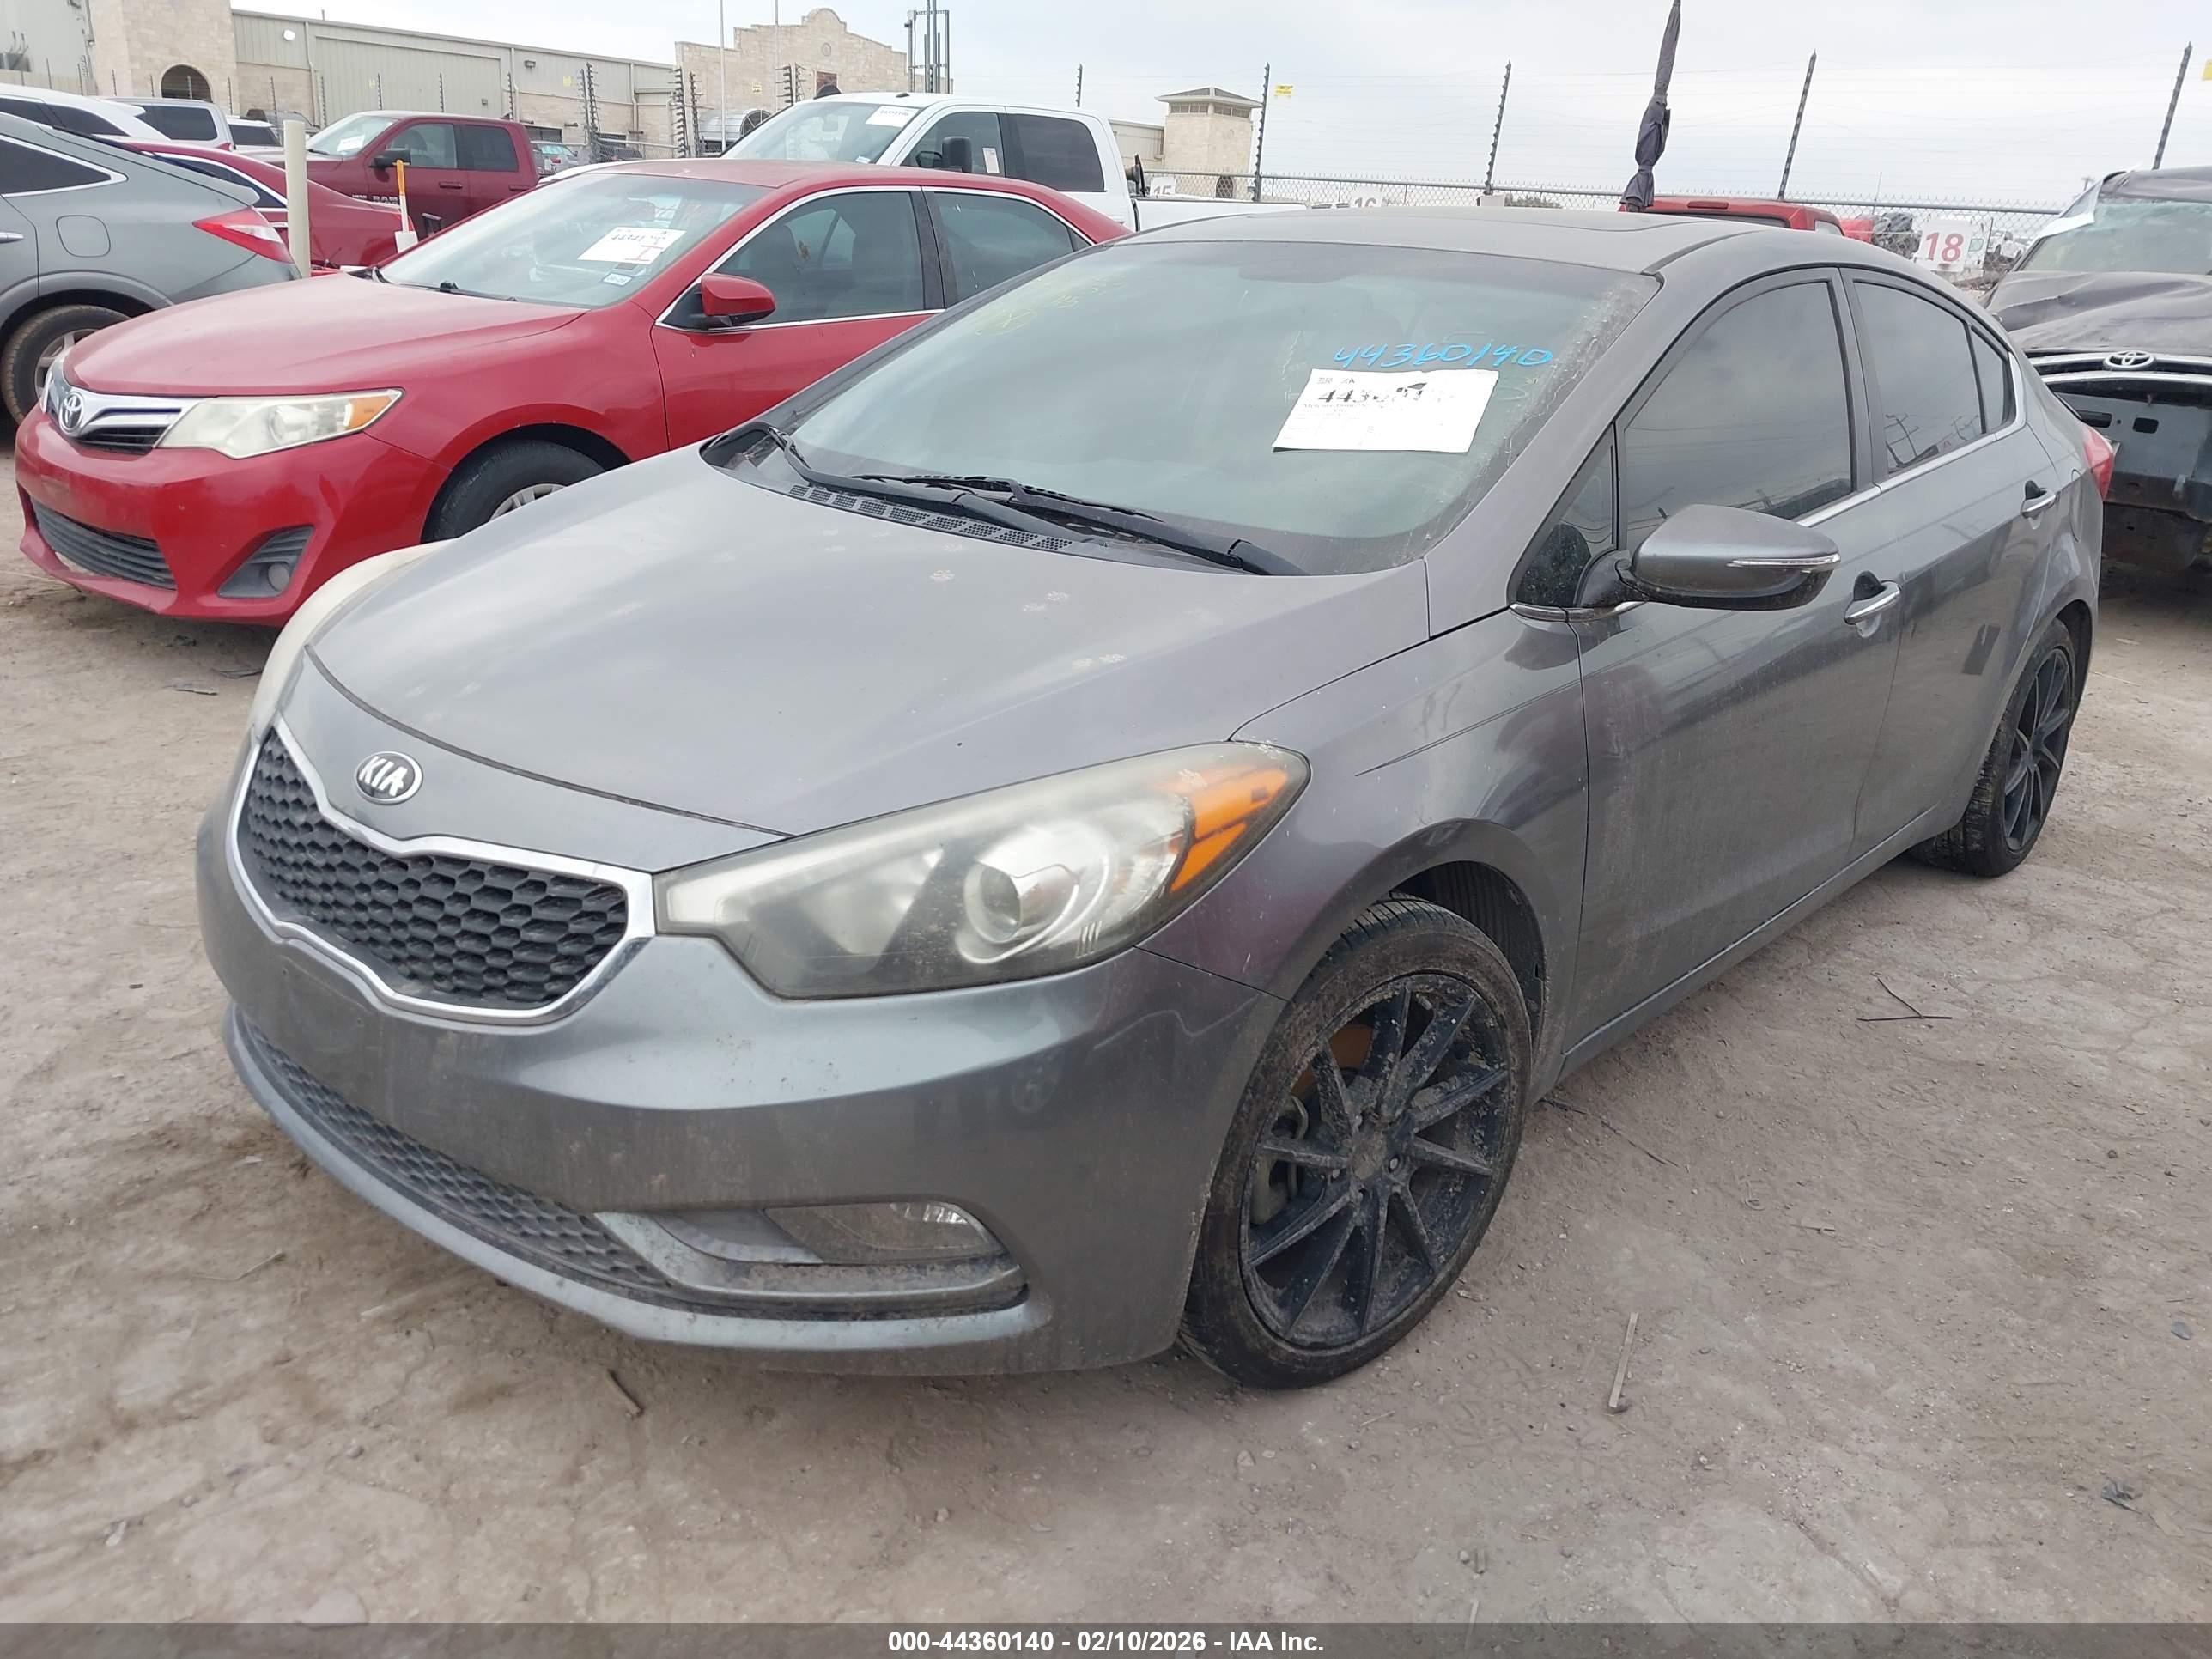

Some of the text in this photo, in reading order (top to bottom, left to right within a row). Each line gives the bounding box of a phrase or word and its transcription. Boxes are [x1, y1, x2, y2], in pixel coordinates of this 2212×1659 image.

[1925, 232, 1964, 262] 18
[1333, 342, 1553, 368] 44360140
[358, 756, 408, 797] KIA
